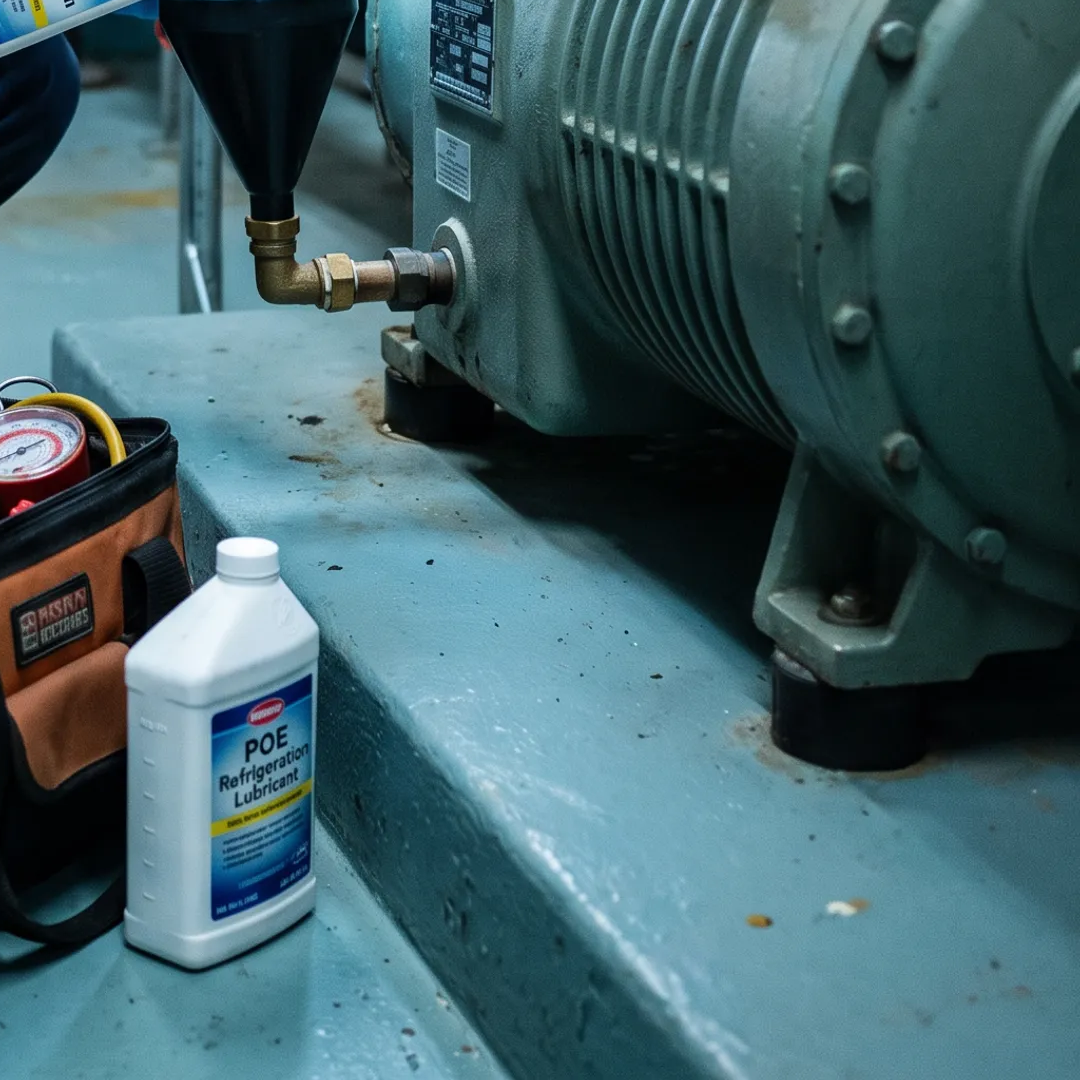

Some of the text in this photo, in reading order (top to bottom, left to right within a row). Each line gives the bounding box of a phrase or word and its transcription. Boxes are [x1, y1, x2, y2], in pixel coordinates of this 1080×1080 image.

[245, 724, 288, 763] POE
[219, 743, 309, 792] Refrigeration
[234, 767, 299, 808] Lubricant
